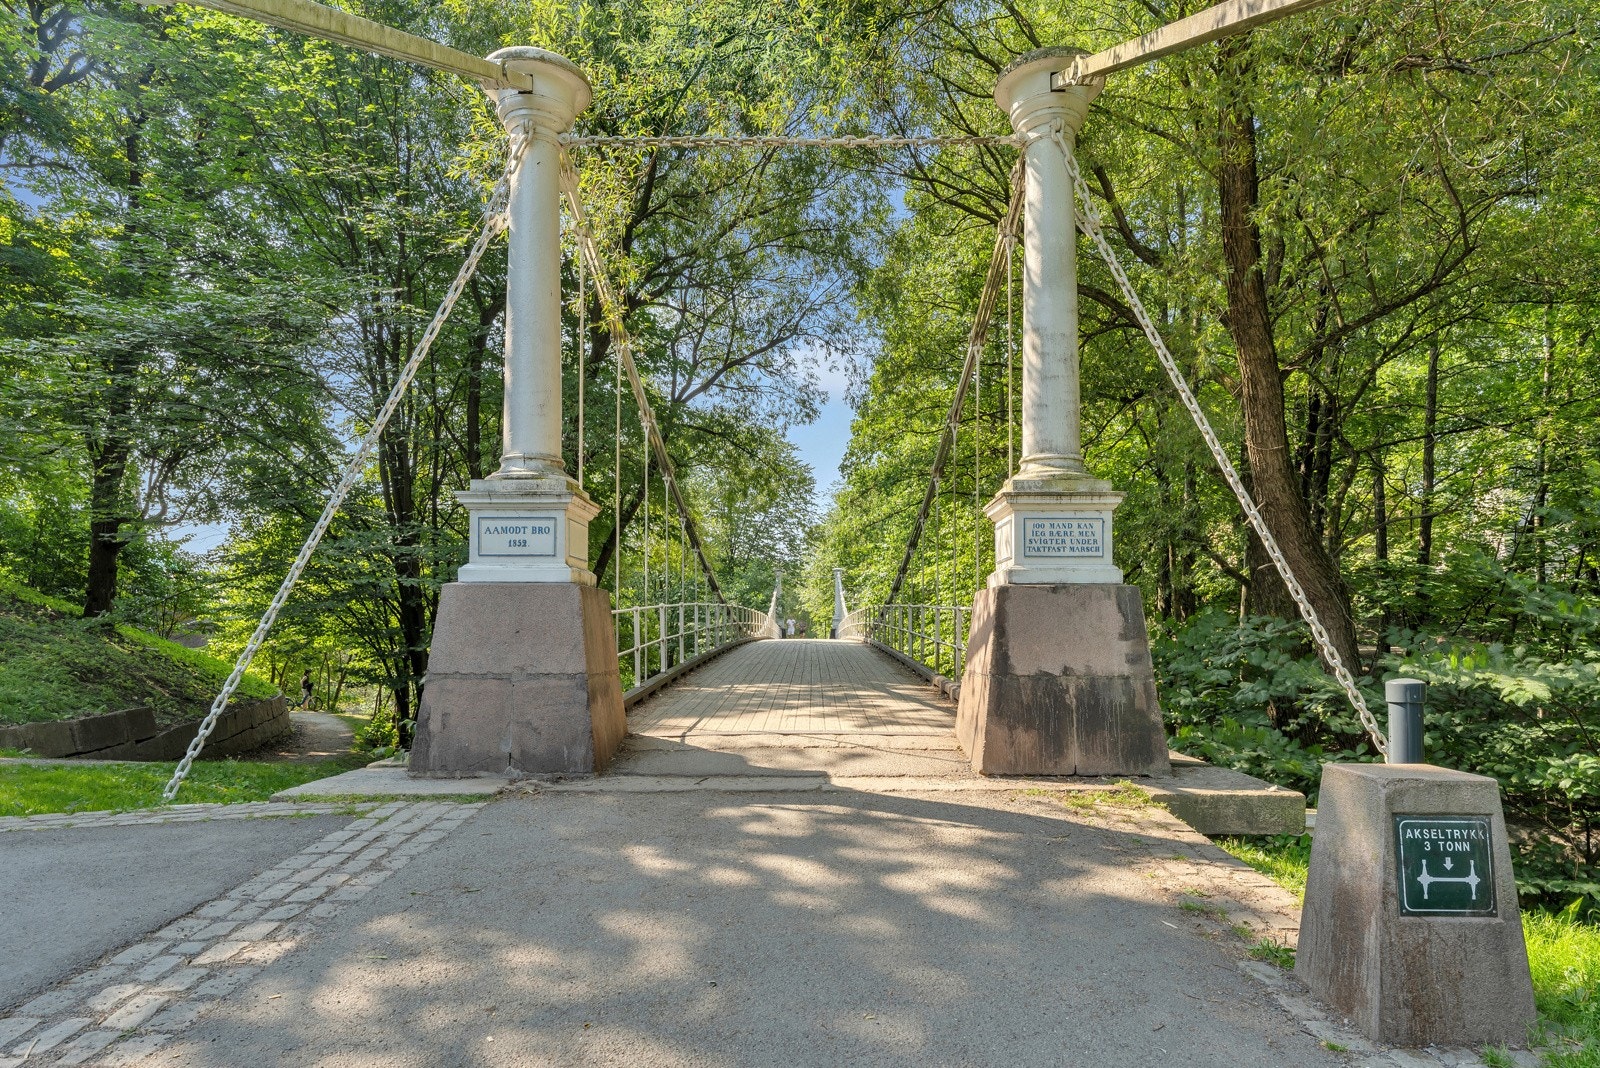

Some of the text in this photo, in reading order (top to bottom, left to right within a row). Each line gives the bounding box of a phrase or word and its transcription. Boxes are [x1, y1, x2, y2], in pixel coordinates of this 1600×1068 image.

[484, 526, 551, 535] AAMODT BRO
[1405, 828, 1485, 840] AKSELTRYKK
[1424, 841, 1471, 852] 3 TONN
